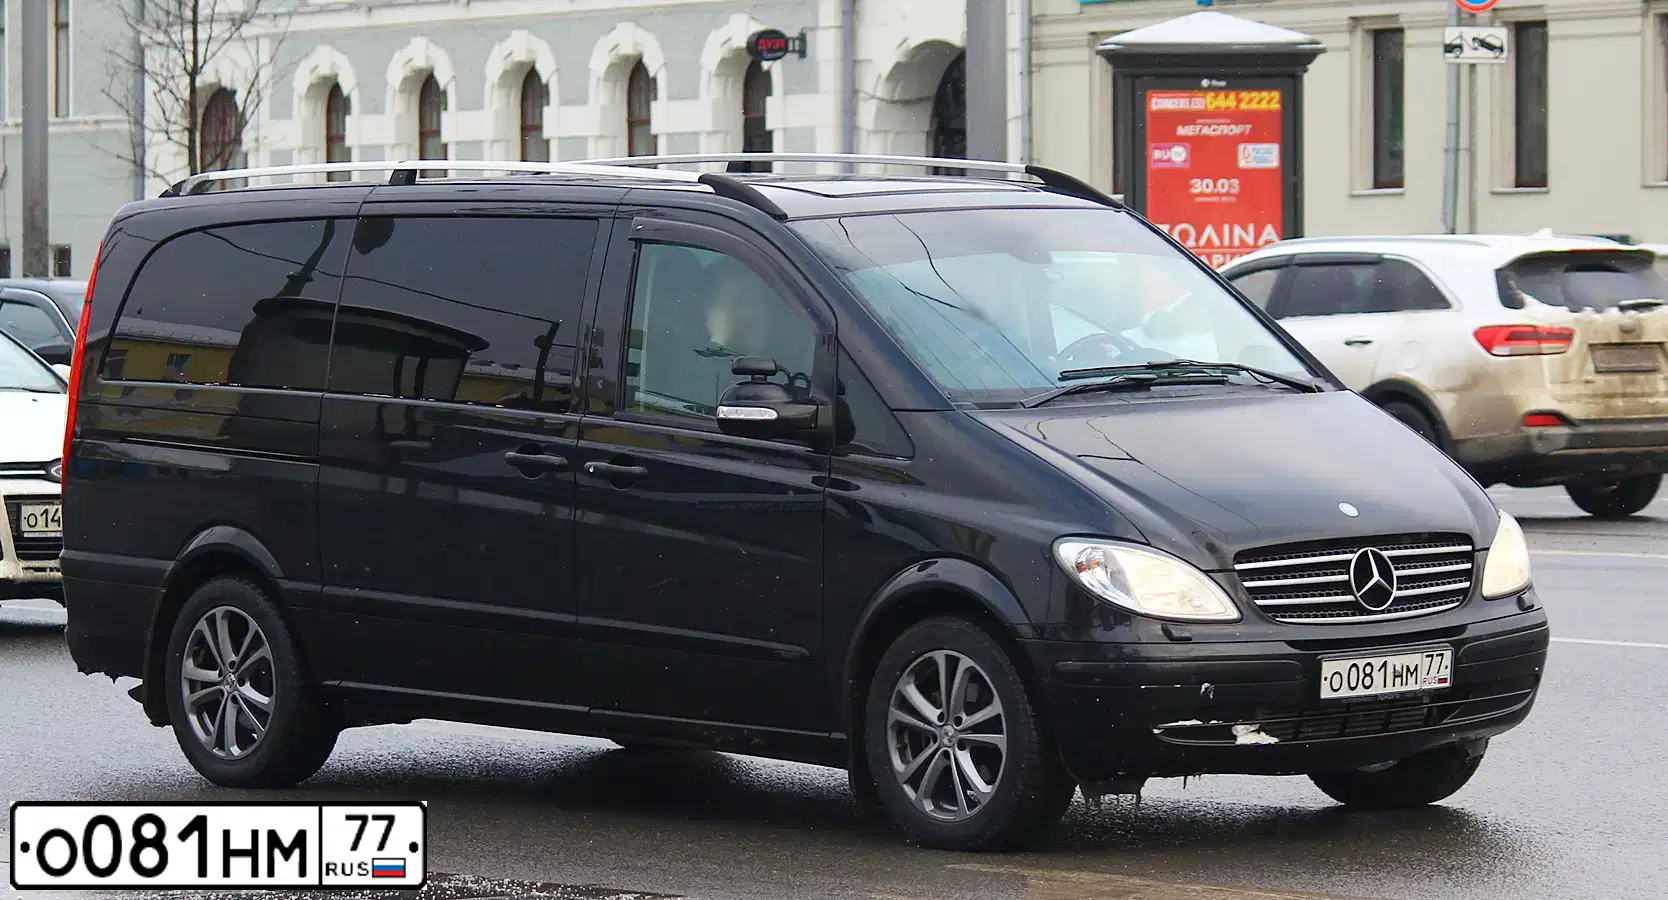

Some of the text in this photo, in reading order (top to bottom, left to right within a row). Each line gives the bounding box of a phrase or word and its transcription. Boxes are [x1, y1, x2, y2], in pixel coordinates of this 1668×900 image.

[1206, 92, 1237, 110] 644
[1240, 91, 1281, 110] 2222
[1176, 124, 1252, 136] МЕГАСПОРТ
[1190, 178, 1240, 194] 30.03
[1425, 652, 1445, 676] 77
[1423, 676, 1438, 685] RUS
